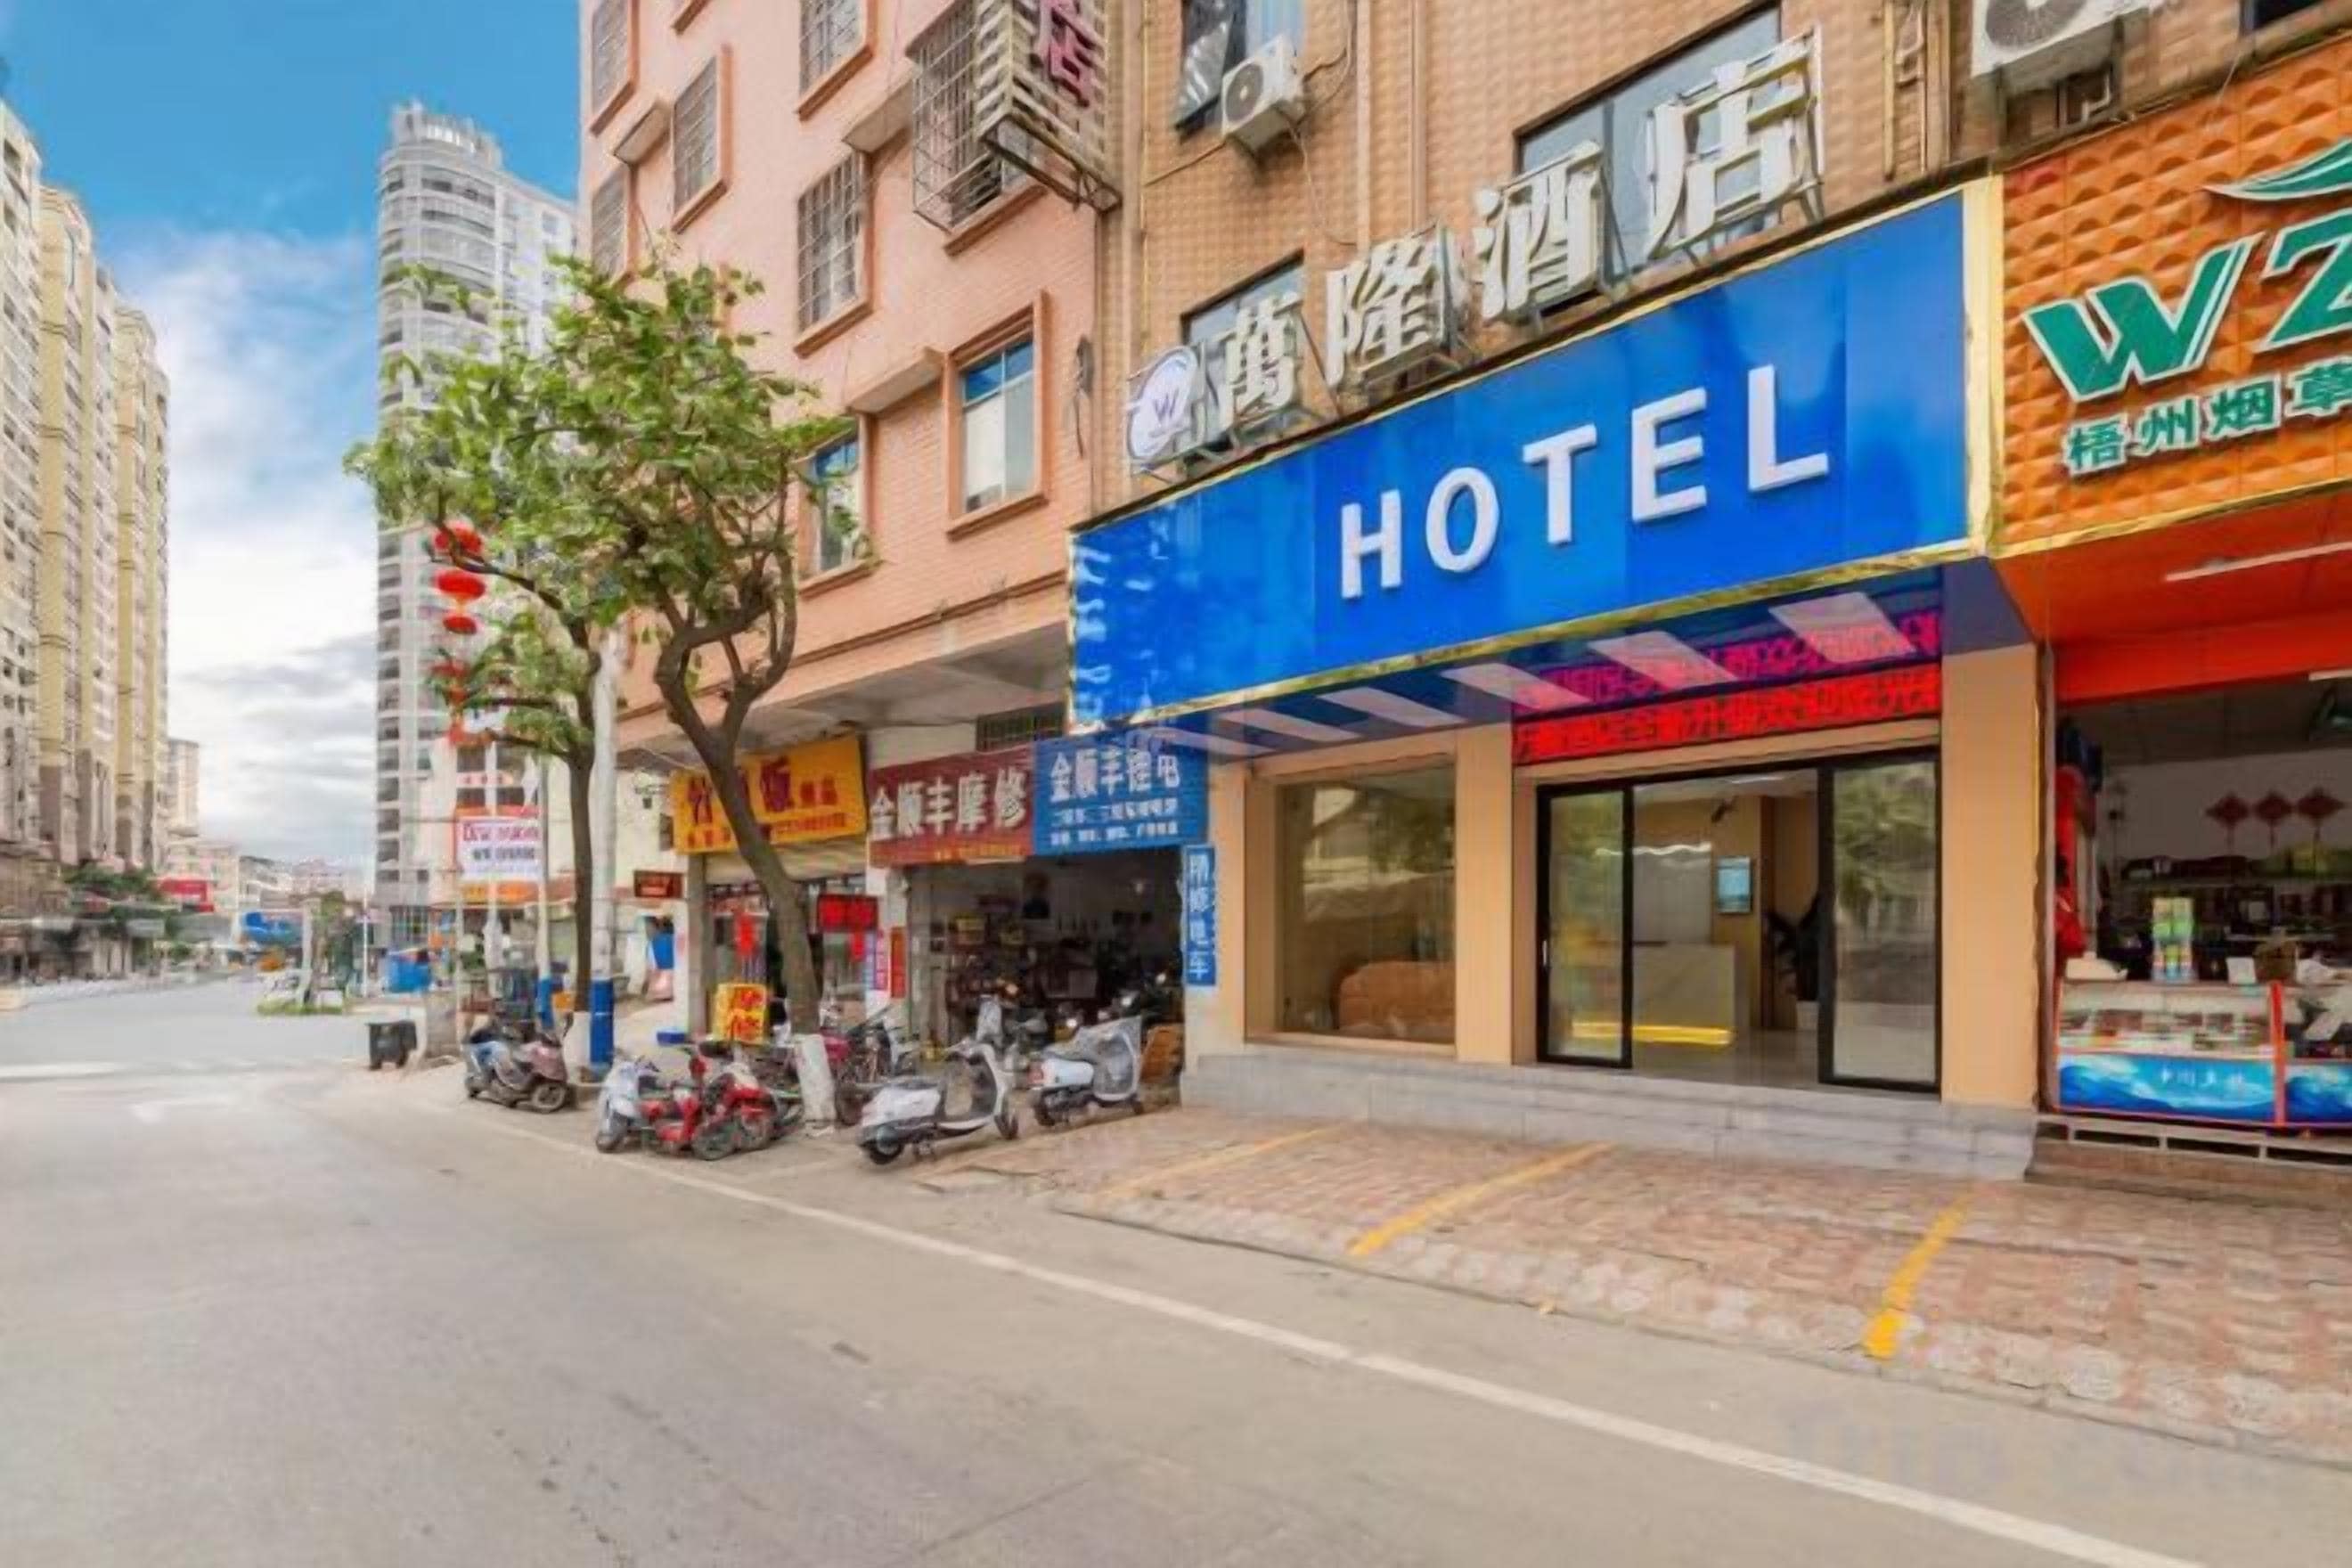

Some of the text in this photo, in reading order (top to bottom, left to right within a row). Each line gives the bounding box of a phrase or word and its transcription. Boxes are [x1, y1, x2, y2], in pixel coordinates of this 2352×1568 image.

[1341, 364, 1829, 600] HOTEL
[2063, 355, 2352, 477] 梧州烟草
